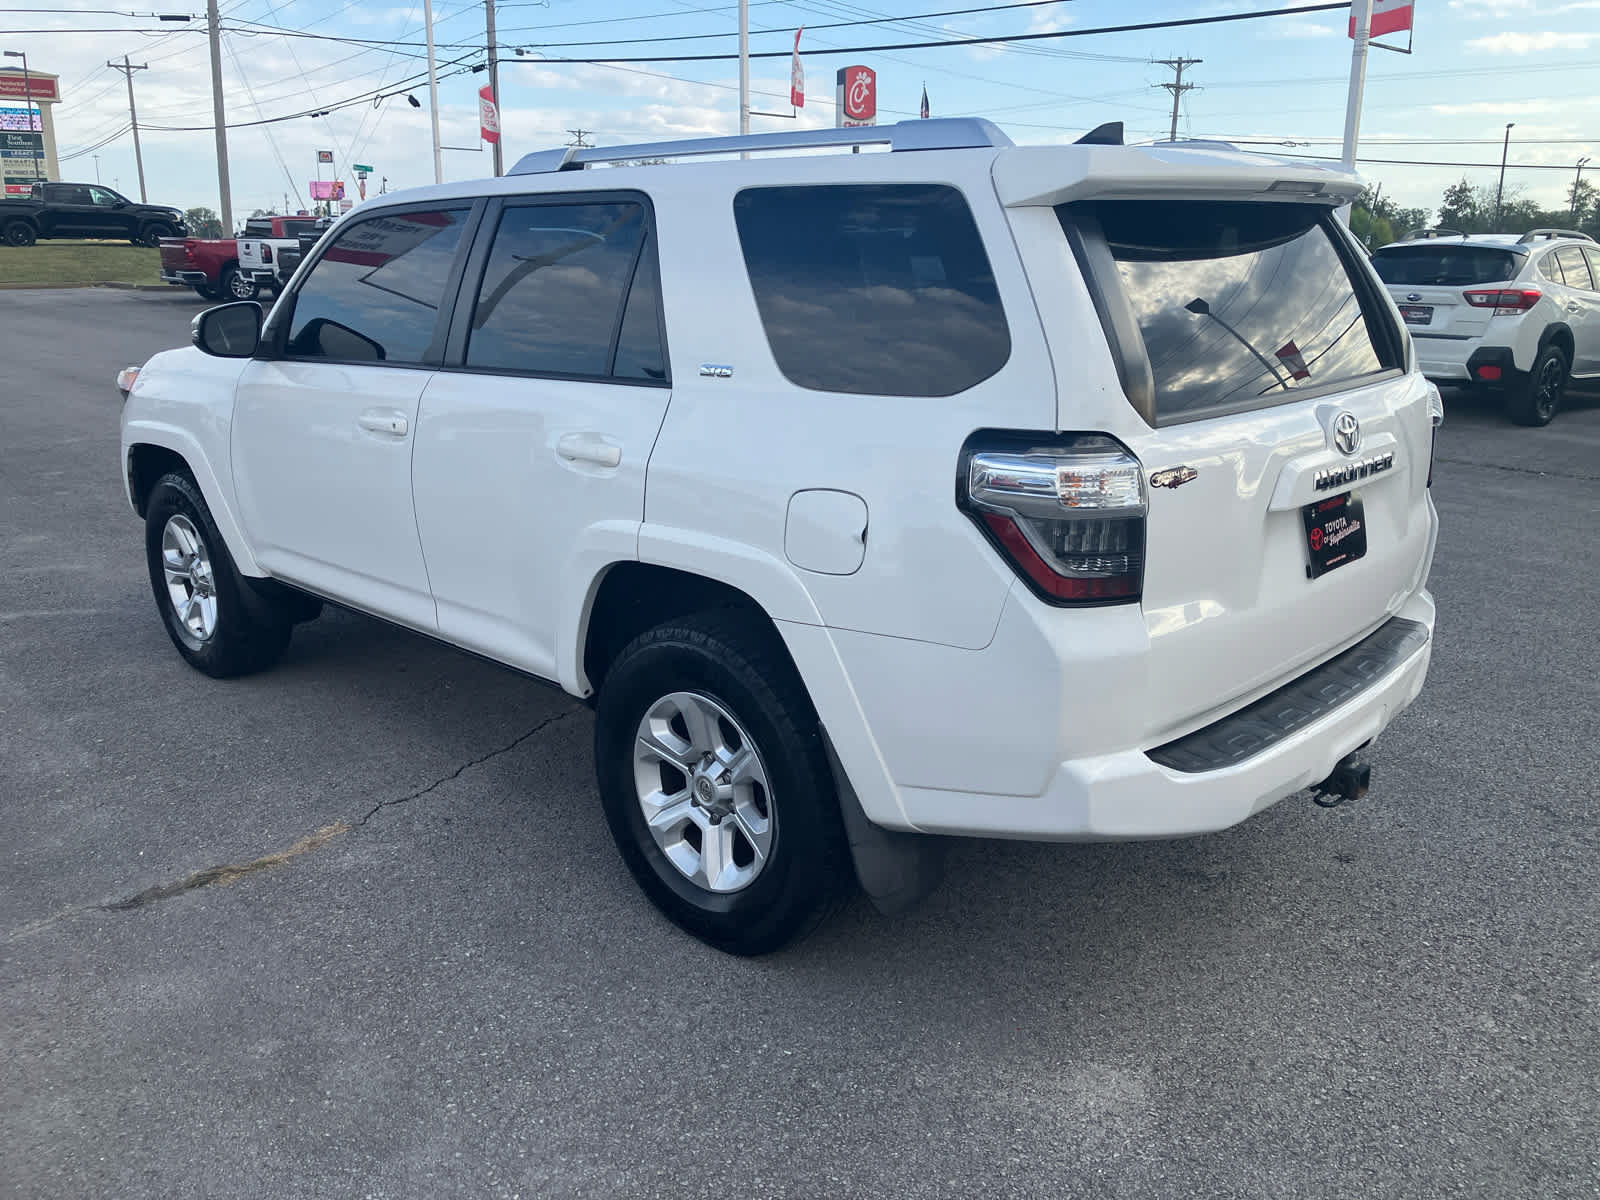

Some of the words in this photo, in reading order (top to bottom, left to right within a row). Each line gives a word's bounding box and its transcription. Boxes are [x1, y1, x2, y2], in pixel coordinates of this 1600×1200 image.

[1313, 452, 1393, 490] 4RUNNER
[1324, 516, 1348, 535] TOYOTA
[1328, 520, 1361, 546] Hopkinsville
